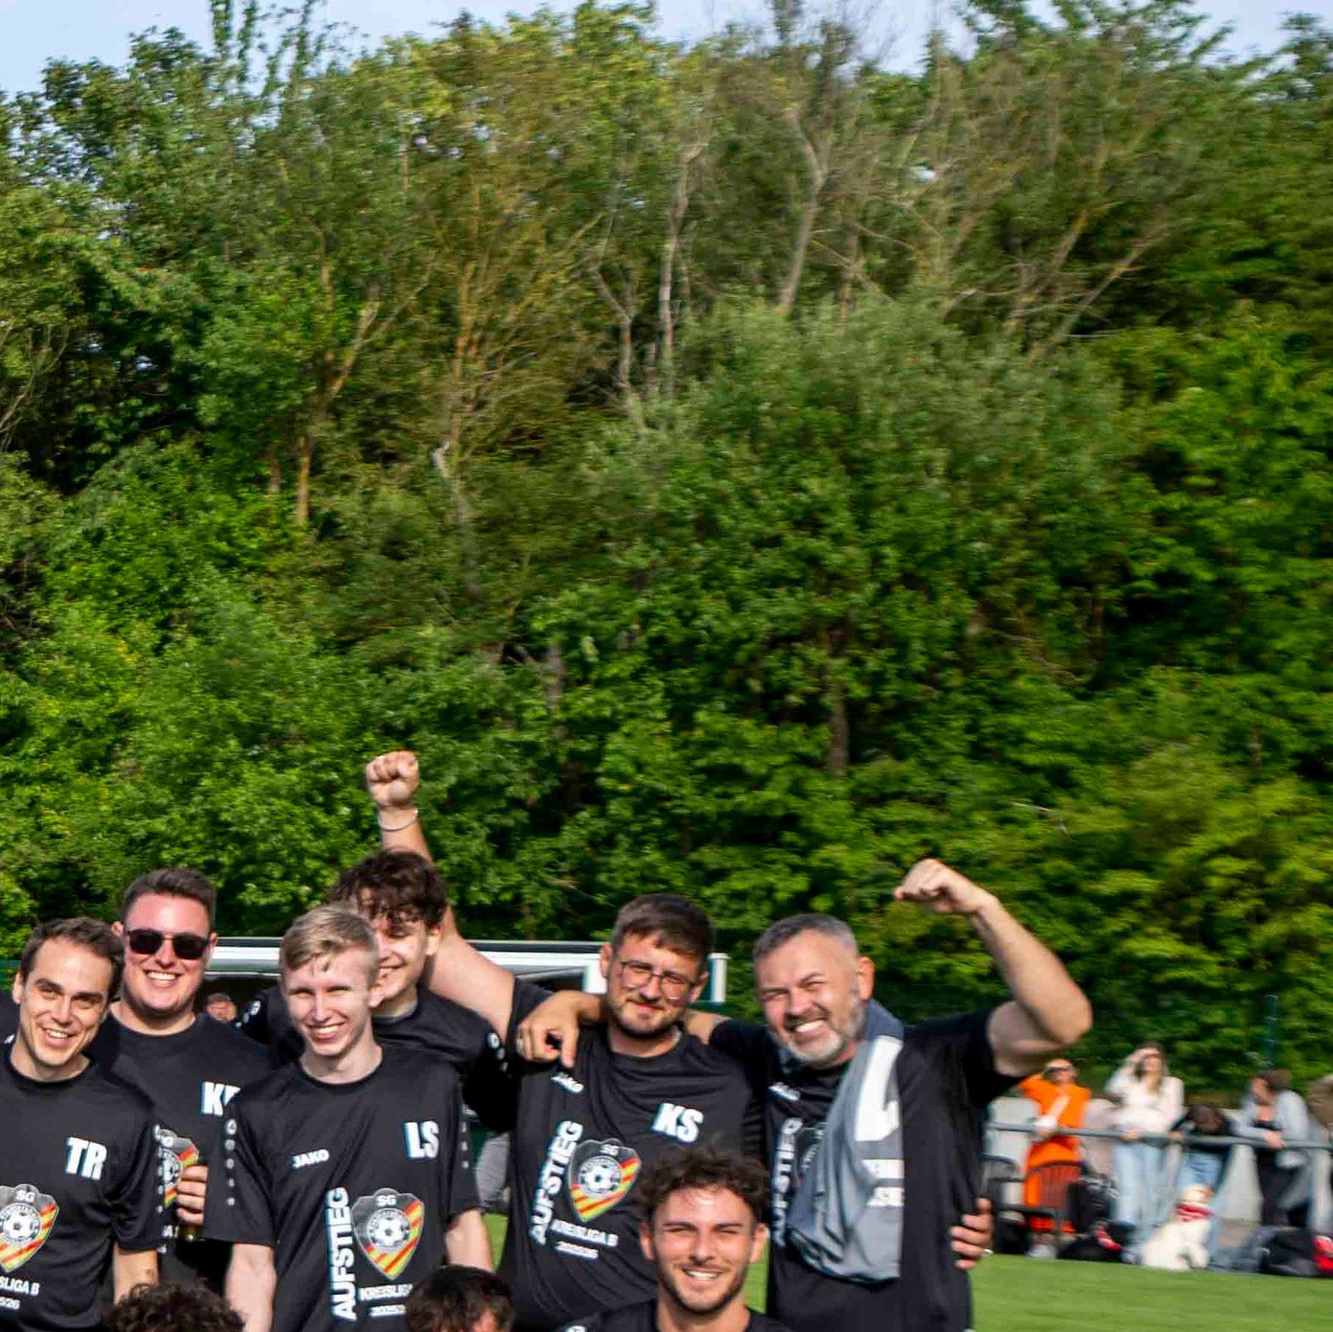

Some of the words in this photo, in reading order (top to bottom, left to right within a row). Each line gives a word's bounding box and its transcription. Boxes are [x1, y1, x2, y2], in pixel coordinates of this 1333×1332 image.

[404, 1120, 440, 1159] LS
[652, 1102, 704, 1143] KS
[65, 1136, 108, 1181] TR
[292, 1149, 330, 1169] JAKO
[16, 1190, 35, 1202] SG
[376, 1194, 397, 1207] SG
[530, 1120, 583, 1246] AUFSTIEG
[326, 1186, 357, 1321] AUFSTIEG
